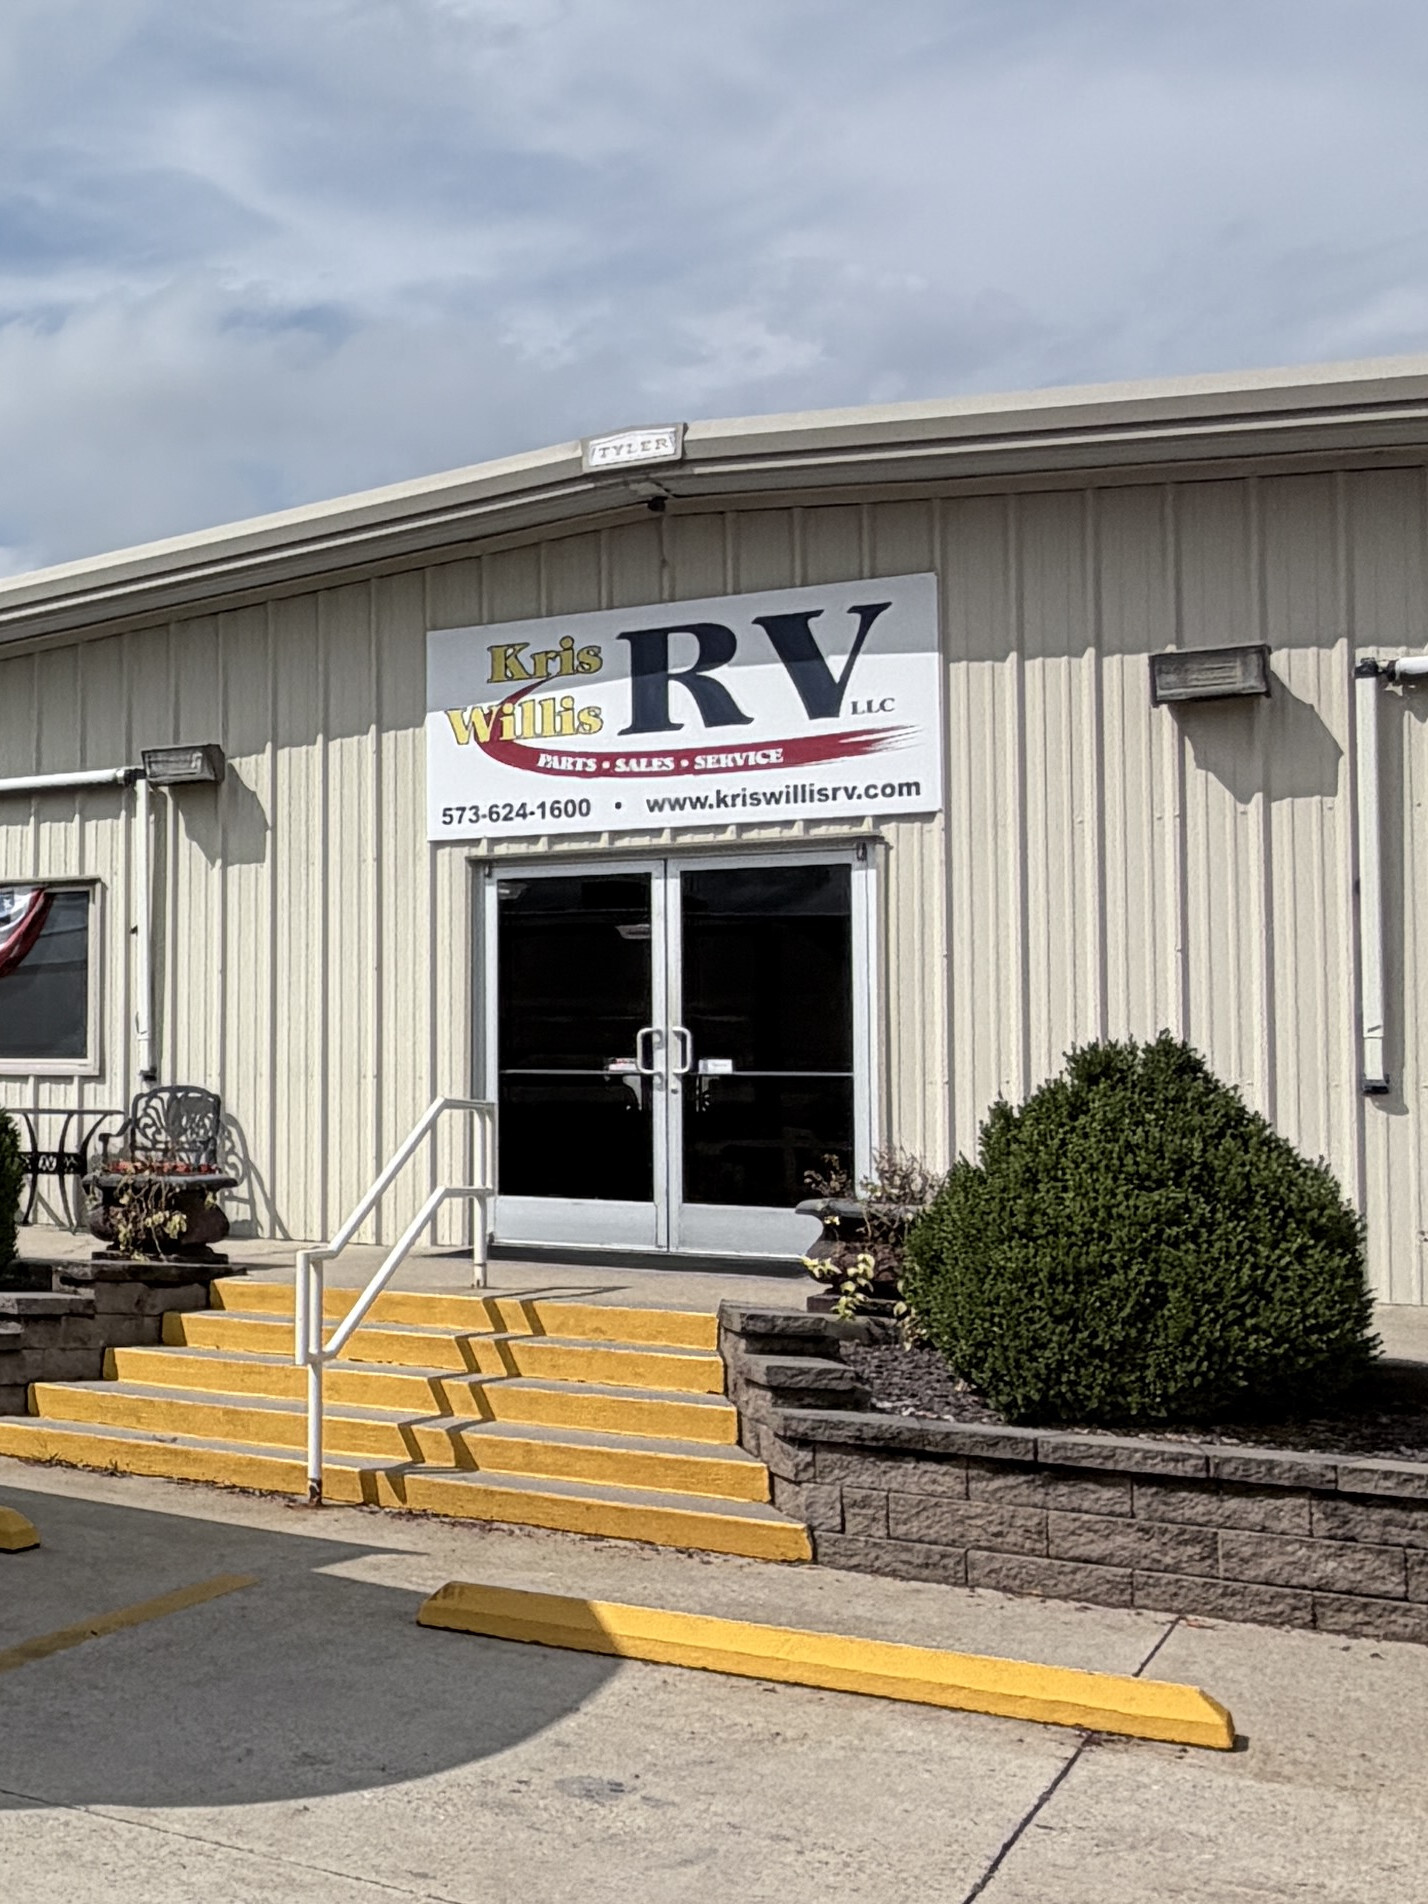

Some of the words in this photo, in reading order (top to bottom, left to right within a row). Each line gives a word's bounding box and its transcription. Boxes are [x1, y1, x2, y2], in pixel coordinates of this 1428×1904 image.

[598, 437, 669, 459] TYLER
[486, 635, 604, 684] Kris
[615, 601, 893, 737] RV
[445, 695, 605, 746] Willis
[849, 696, 896, 717] LLC
[536, 752, 598, 772] PARTS
[614, 756, 675, 773] SALES
[693, 747, 785, 771] SERVICE
[440, 797, 593, 826] 573-624-1600
[645, 776, 923, 814] www.kriswillisrv.com
